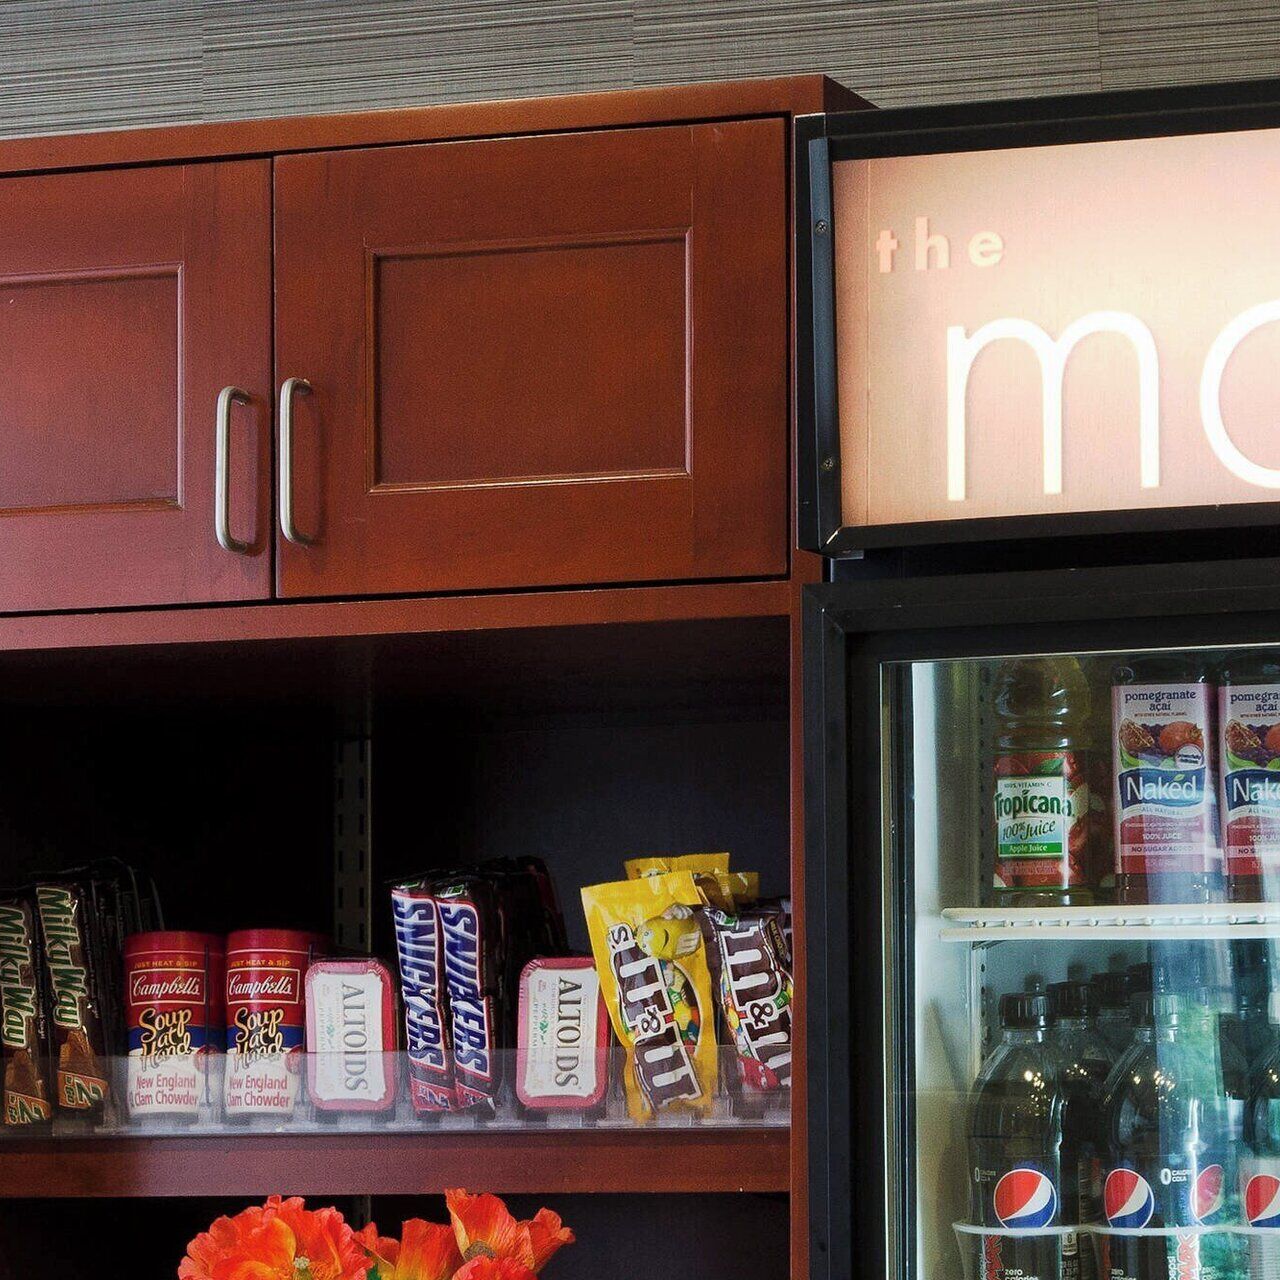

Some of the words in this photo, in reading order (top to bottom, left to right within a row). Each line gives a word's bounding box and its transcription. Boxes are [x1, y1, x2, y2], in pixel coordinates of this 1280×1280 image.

[876, 219, 1006, 273] the
[1124, 690, 1196, 703] pomegranate
[1127, 774, 1198, 800] Naked
[993, 790, 1072, 821] Tropicana
[1021, 819, 1056, 840] Juice
[1027, 844, 1047, 852] Juice
[1142, 845, 1165, 853] SUGAR
[37, 887, 80, 967] Milky
[133, 975, 200, 998] Campbell's
[228, 975, 292, 998] Campbell's
[392, 900, 446, 1069] SNICKERS
[51, 965, 86, 1028] Way
[2, 984, 35, 1048] Way
[139, 1006, 192, 1043] Soup
[234, 1006, 284, 1041] Soup
[157, 1026, 178, 1046] at
[250, 1026, 269, 1047] at
[341, 982, 368, 1091] ALTOIDS
[554, 976, 582, 1087] ALTOIDS
[136, 1076, 154, 1088] New
[156, 1073, 196, 1090] England
[229, 1077, 243, 1088] New
[246, 1074, 287, 1090] England
[134, 1093, 153, 1105] Clam
[156, 1092, 198, 1107] Chowder
[249, 1094, 290, 1107] Chowder
[1160, 1168, 1172, 1185] 0
